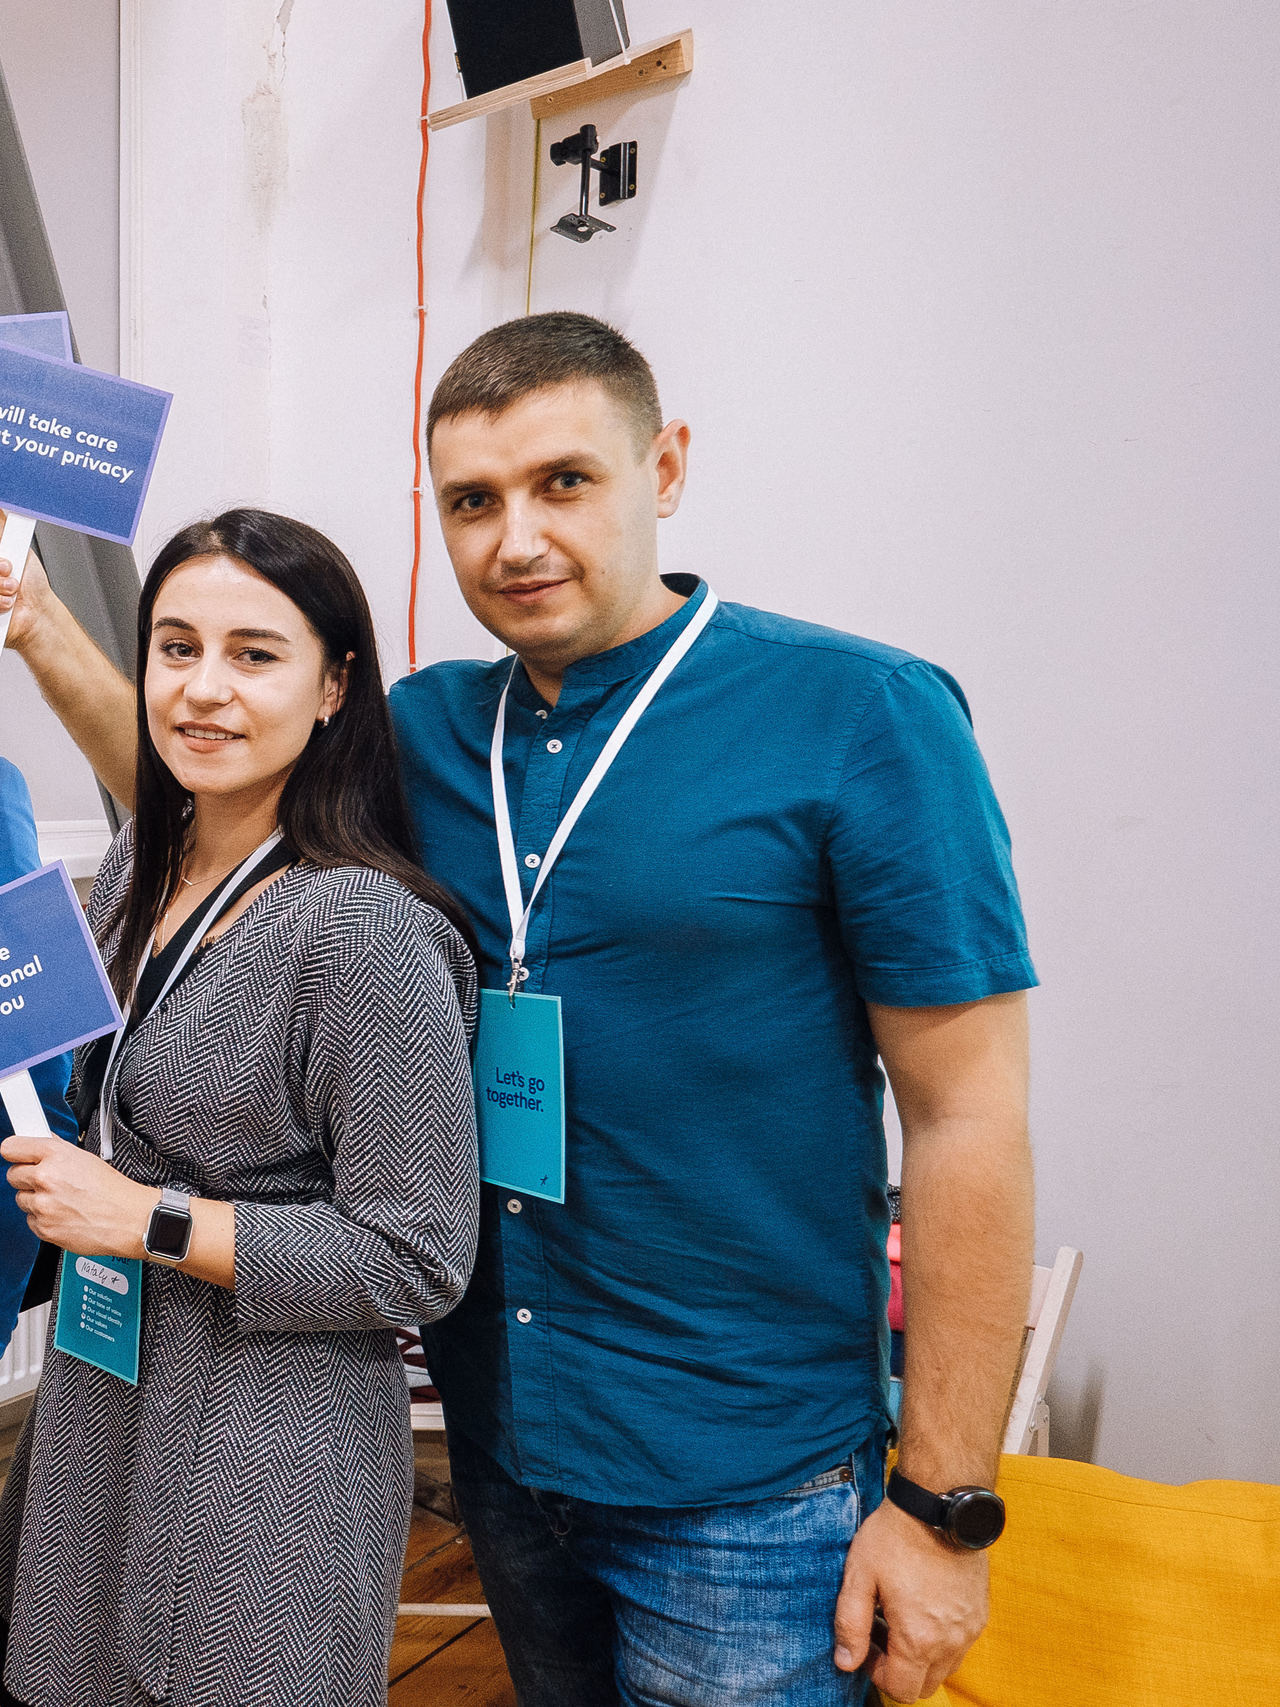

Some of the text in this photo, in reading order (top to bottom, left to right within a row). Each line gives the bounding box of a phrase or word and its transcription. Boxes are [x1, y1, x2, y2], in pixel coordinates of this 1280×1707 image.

[28, 413, 72, 439] take
[75, 431, 118, 453] care
[13, 435, 60, 459] your
[60, 450, 134, 484] privacy
[495, 1066, 545, 1095] Let's go
[485, 1086, 544, 1112] together.
